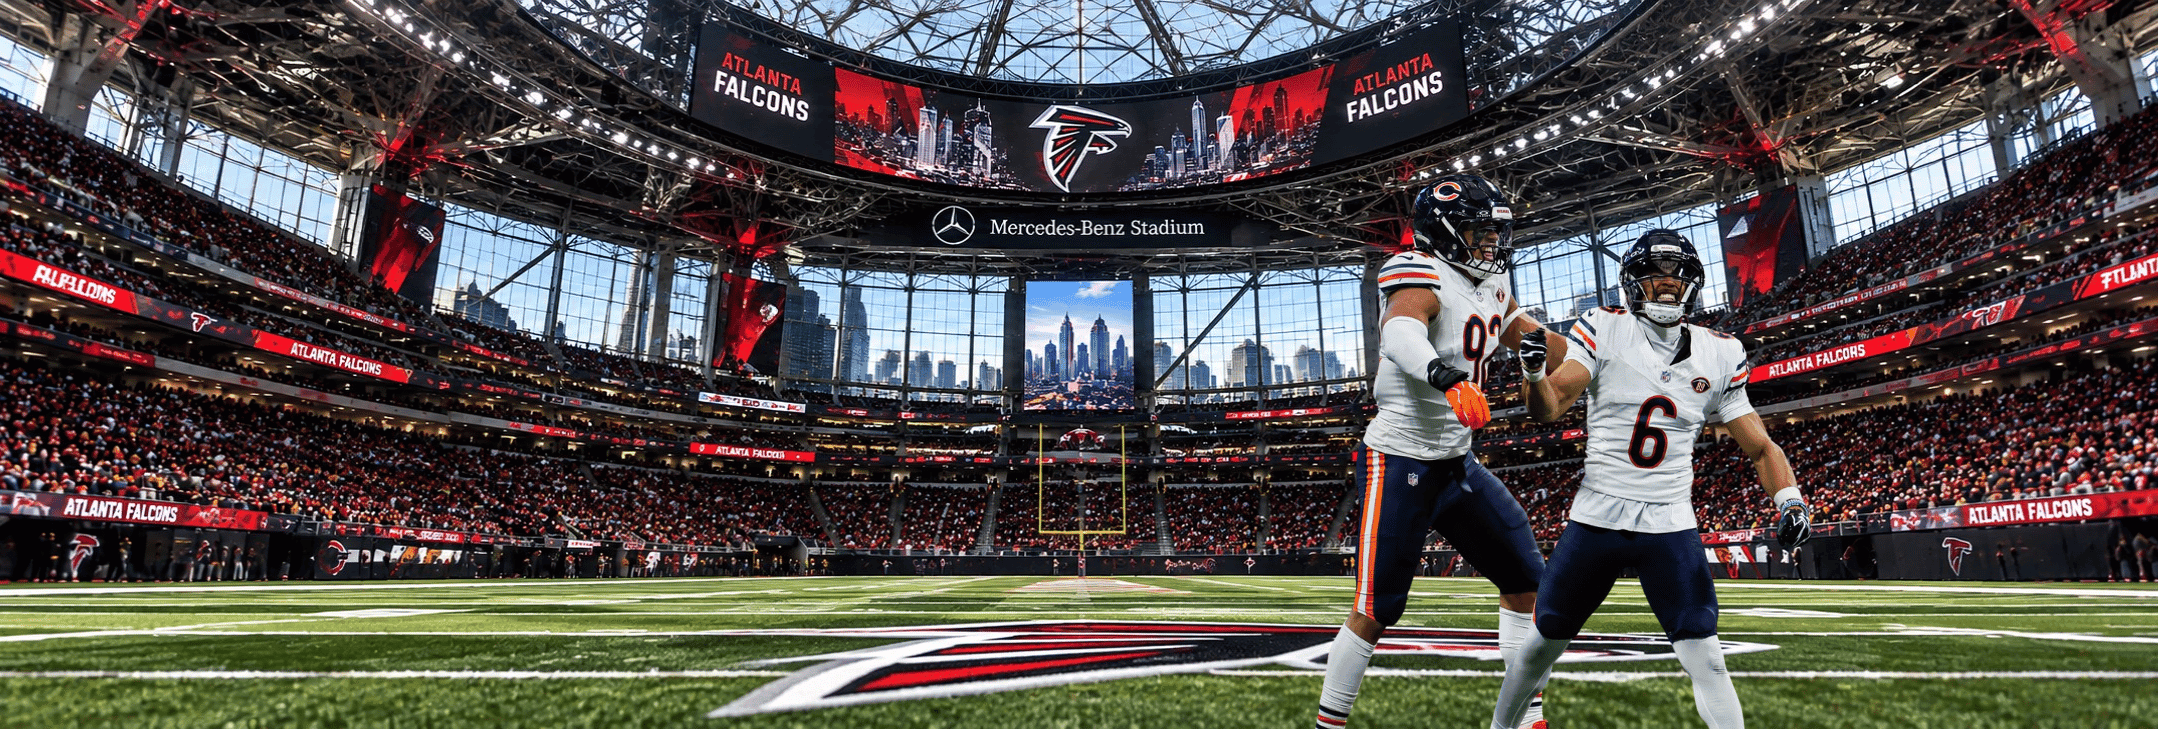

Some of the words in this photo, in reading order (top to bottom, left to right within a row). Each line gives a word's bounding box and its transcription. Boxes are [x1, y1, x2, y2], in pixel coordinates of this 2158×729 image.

[722, 52, 802, 95] ATLANTA
[1353, 53, 1434, 95] ATLANTA
[713, 69, 809, 122] FALCONS
[1346, 71, 1444, 123] FALCONS
[990, 219, 1125, 236] Mercedes-Benz
[1130, 219, 1205, 235] Stadium
[290, 342, 337, 366] ATLANTA
[338, 354, 382, 376] FALCONS
[1768, 359, 1814, 378] ATLANTA
[1628, 395, 1677, 469] 6
[715, 445, 750, 457] ATLANTA
[63, 498, 123, 519] ATLANTA
[125, 502, 178, 522] FALCONS
[1968, 503, 2025, 525] ATLANTA
[2027, 498, 2093, 520] FALCONS
